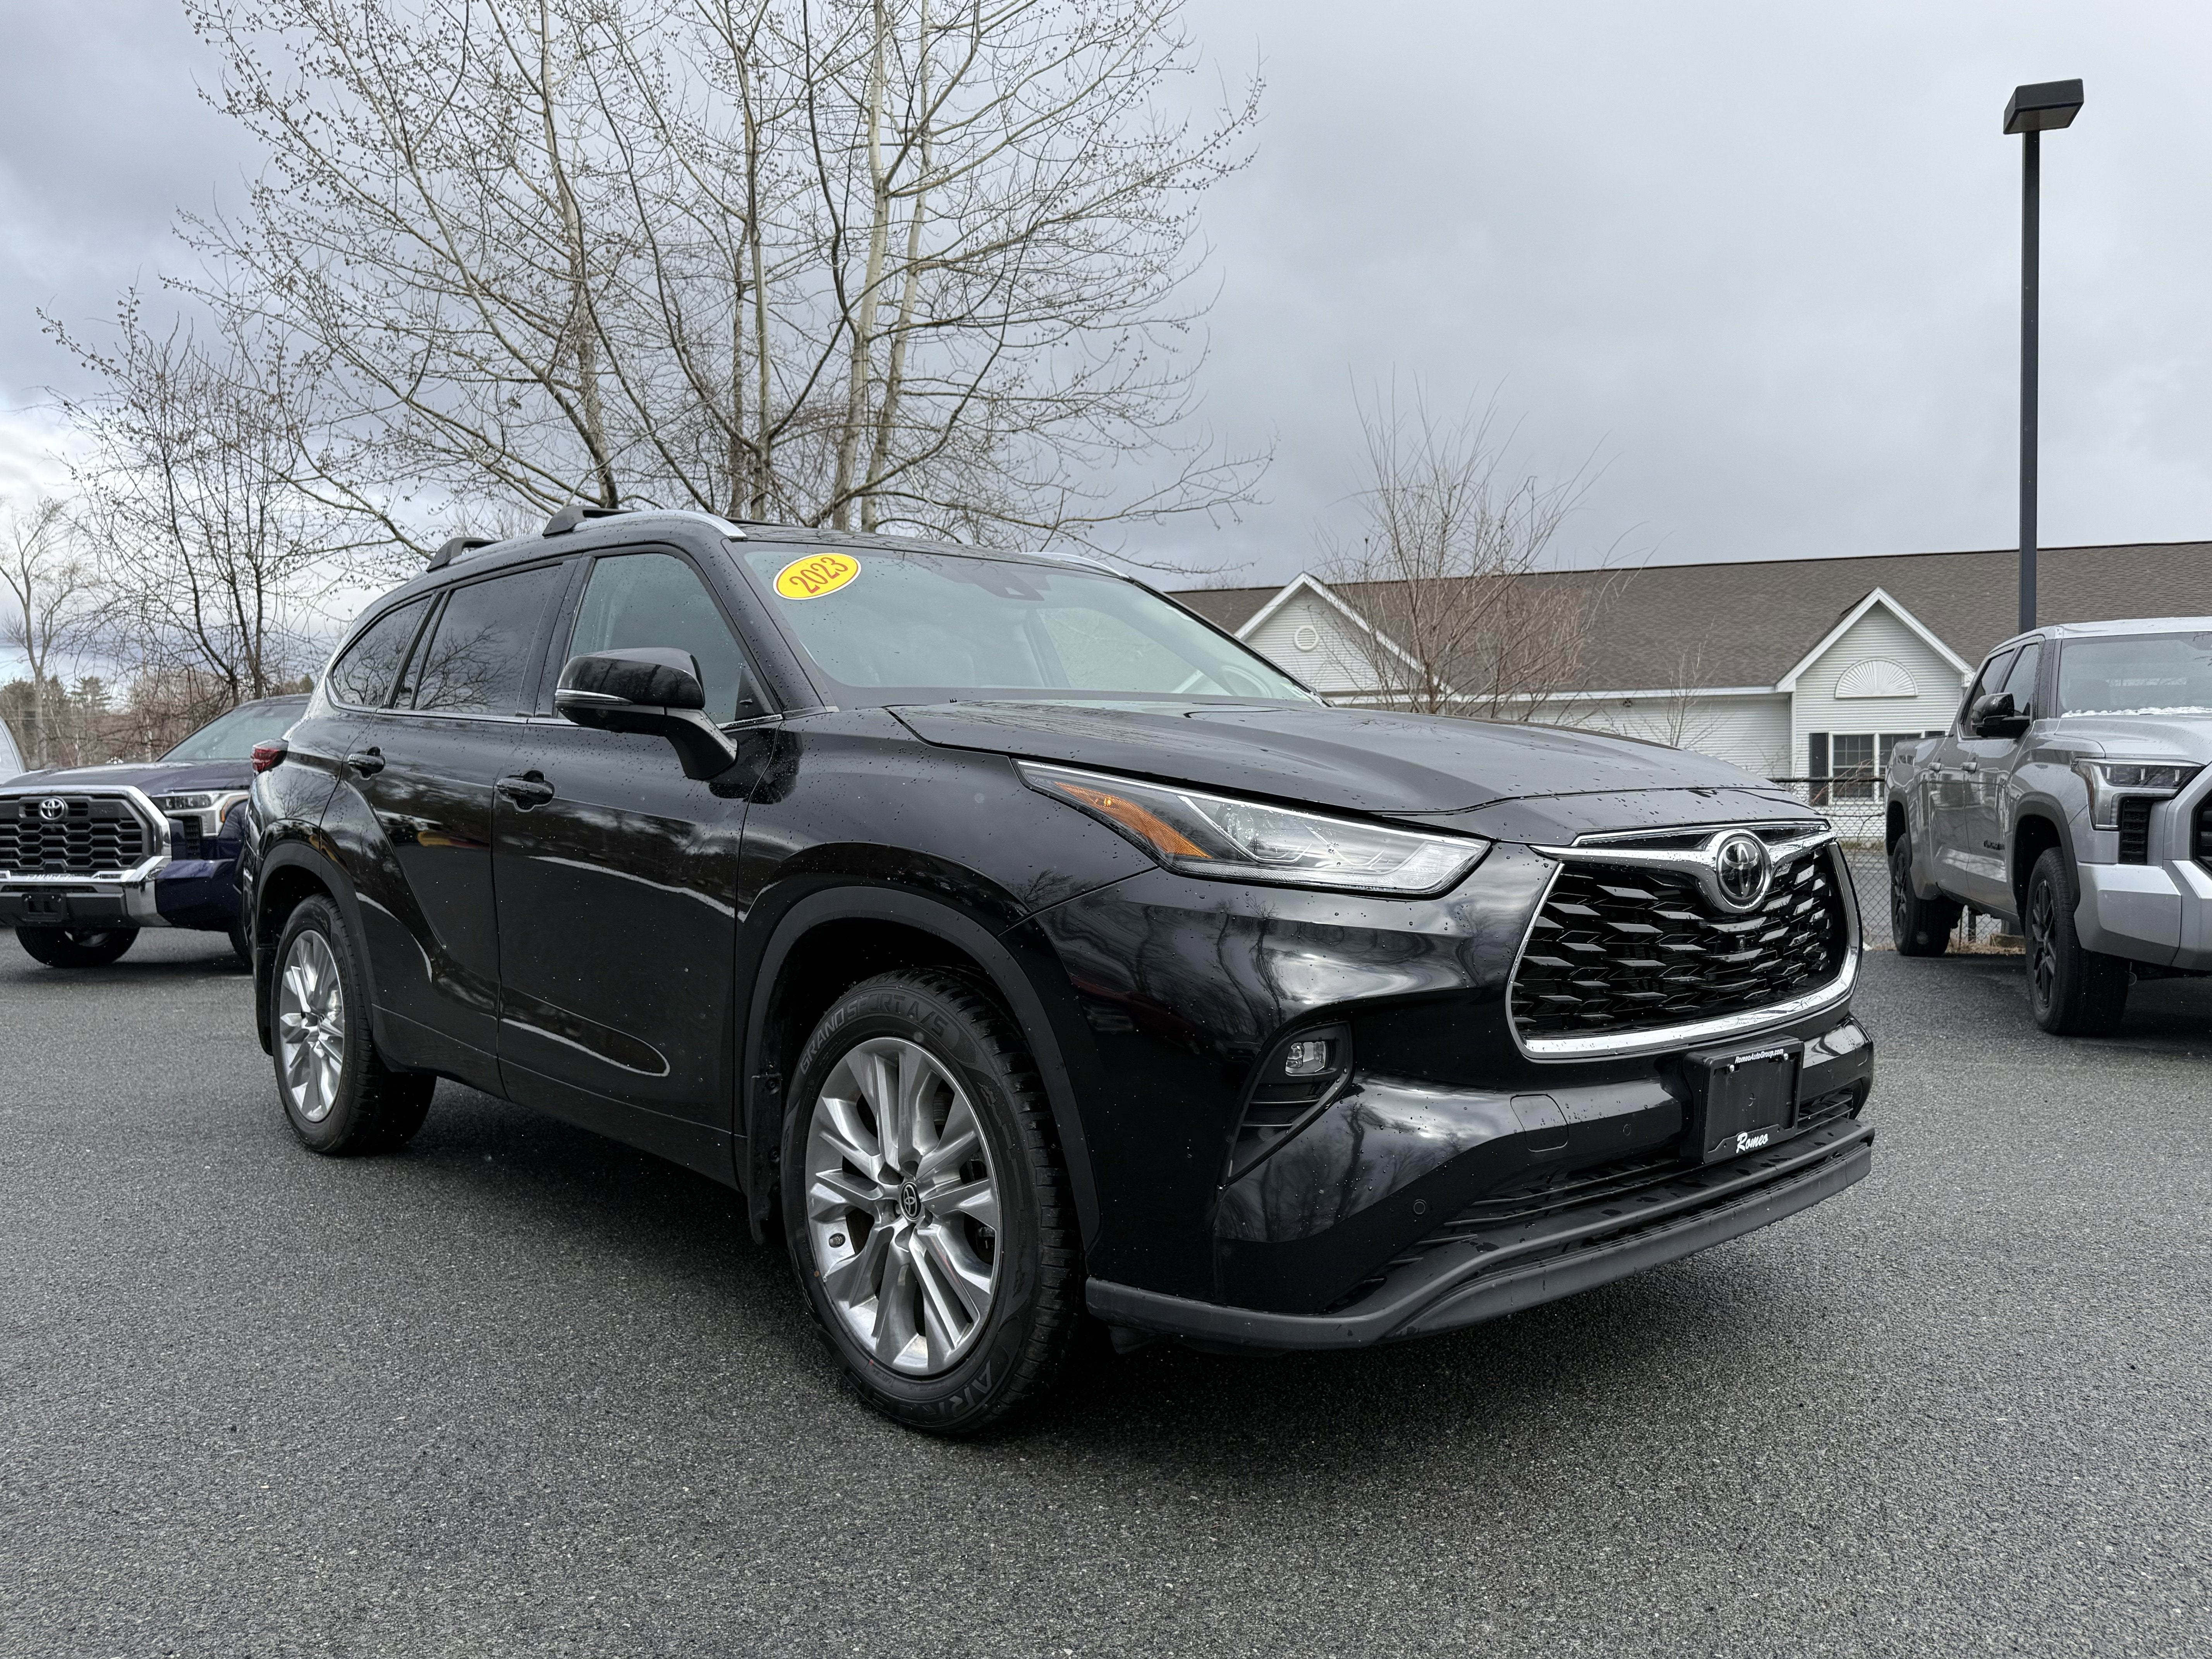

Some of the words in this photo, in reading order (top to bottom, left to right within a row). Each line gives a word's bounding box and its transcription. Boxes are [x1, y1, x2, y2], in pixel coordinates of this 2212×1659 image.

[789, 557, 848, 594] 2023
[800, 1008, 845, 1075] GRAND
[847, 993, 906, 1018] SPORT
[907, 1001, 948, 1037] A/S
[1735, 1048, 1784, 1064] RomeoAutoGroup.com
[1736, 1132, 1769, 1153] Romeo
